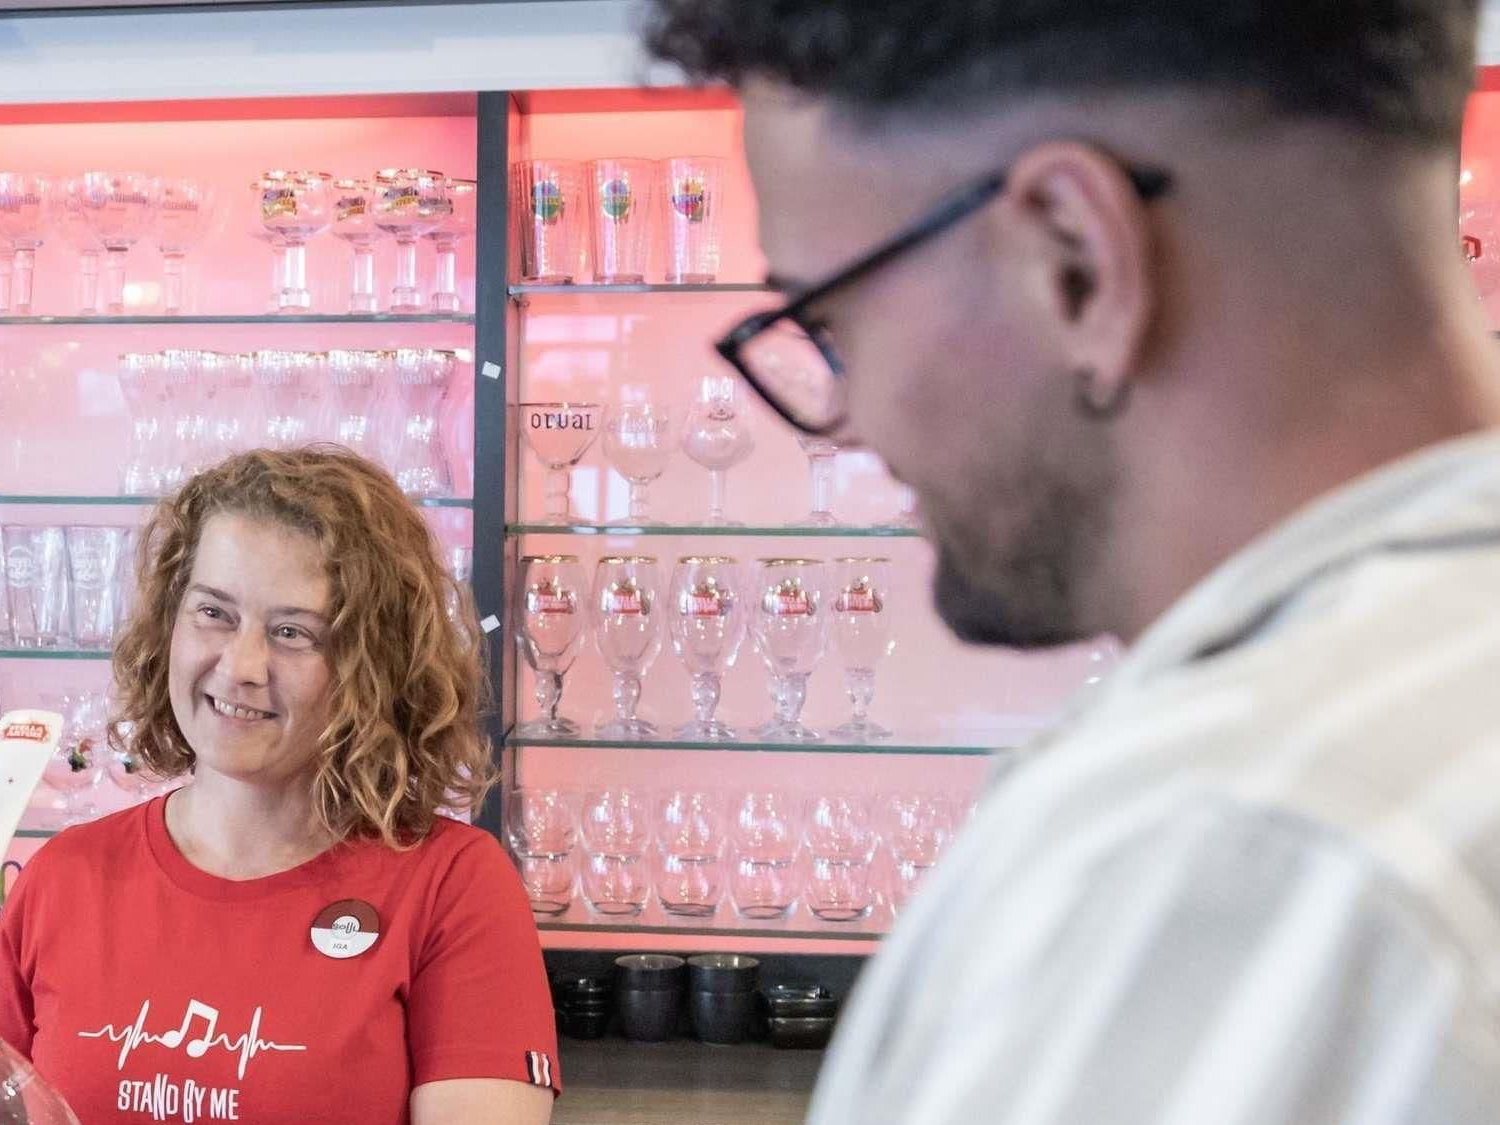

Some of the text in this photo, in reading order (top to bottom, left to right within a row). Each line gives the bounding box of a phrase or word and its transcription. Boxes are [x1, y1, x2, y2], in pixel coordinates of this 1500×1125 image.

[117, 1073, 240, 1124] STAND BY ME
